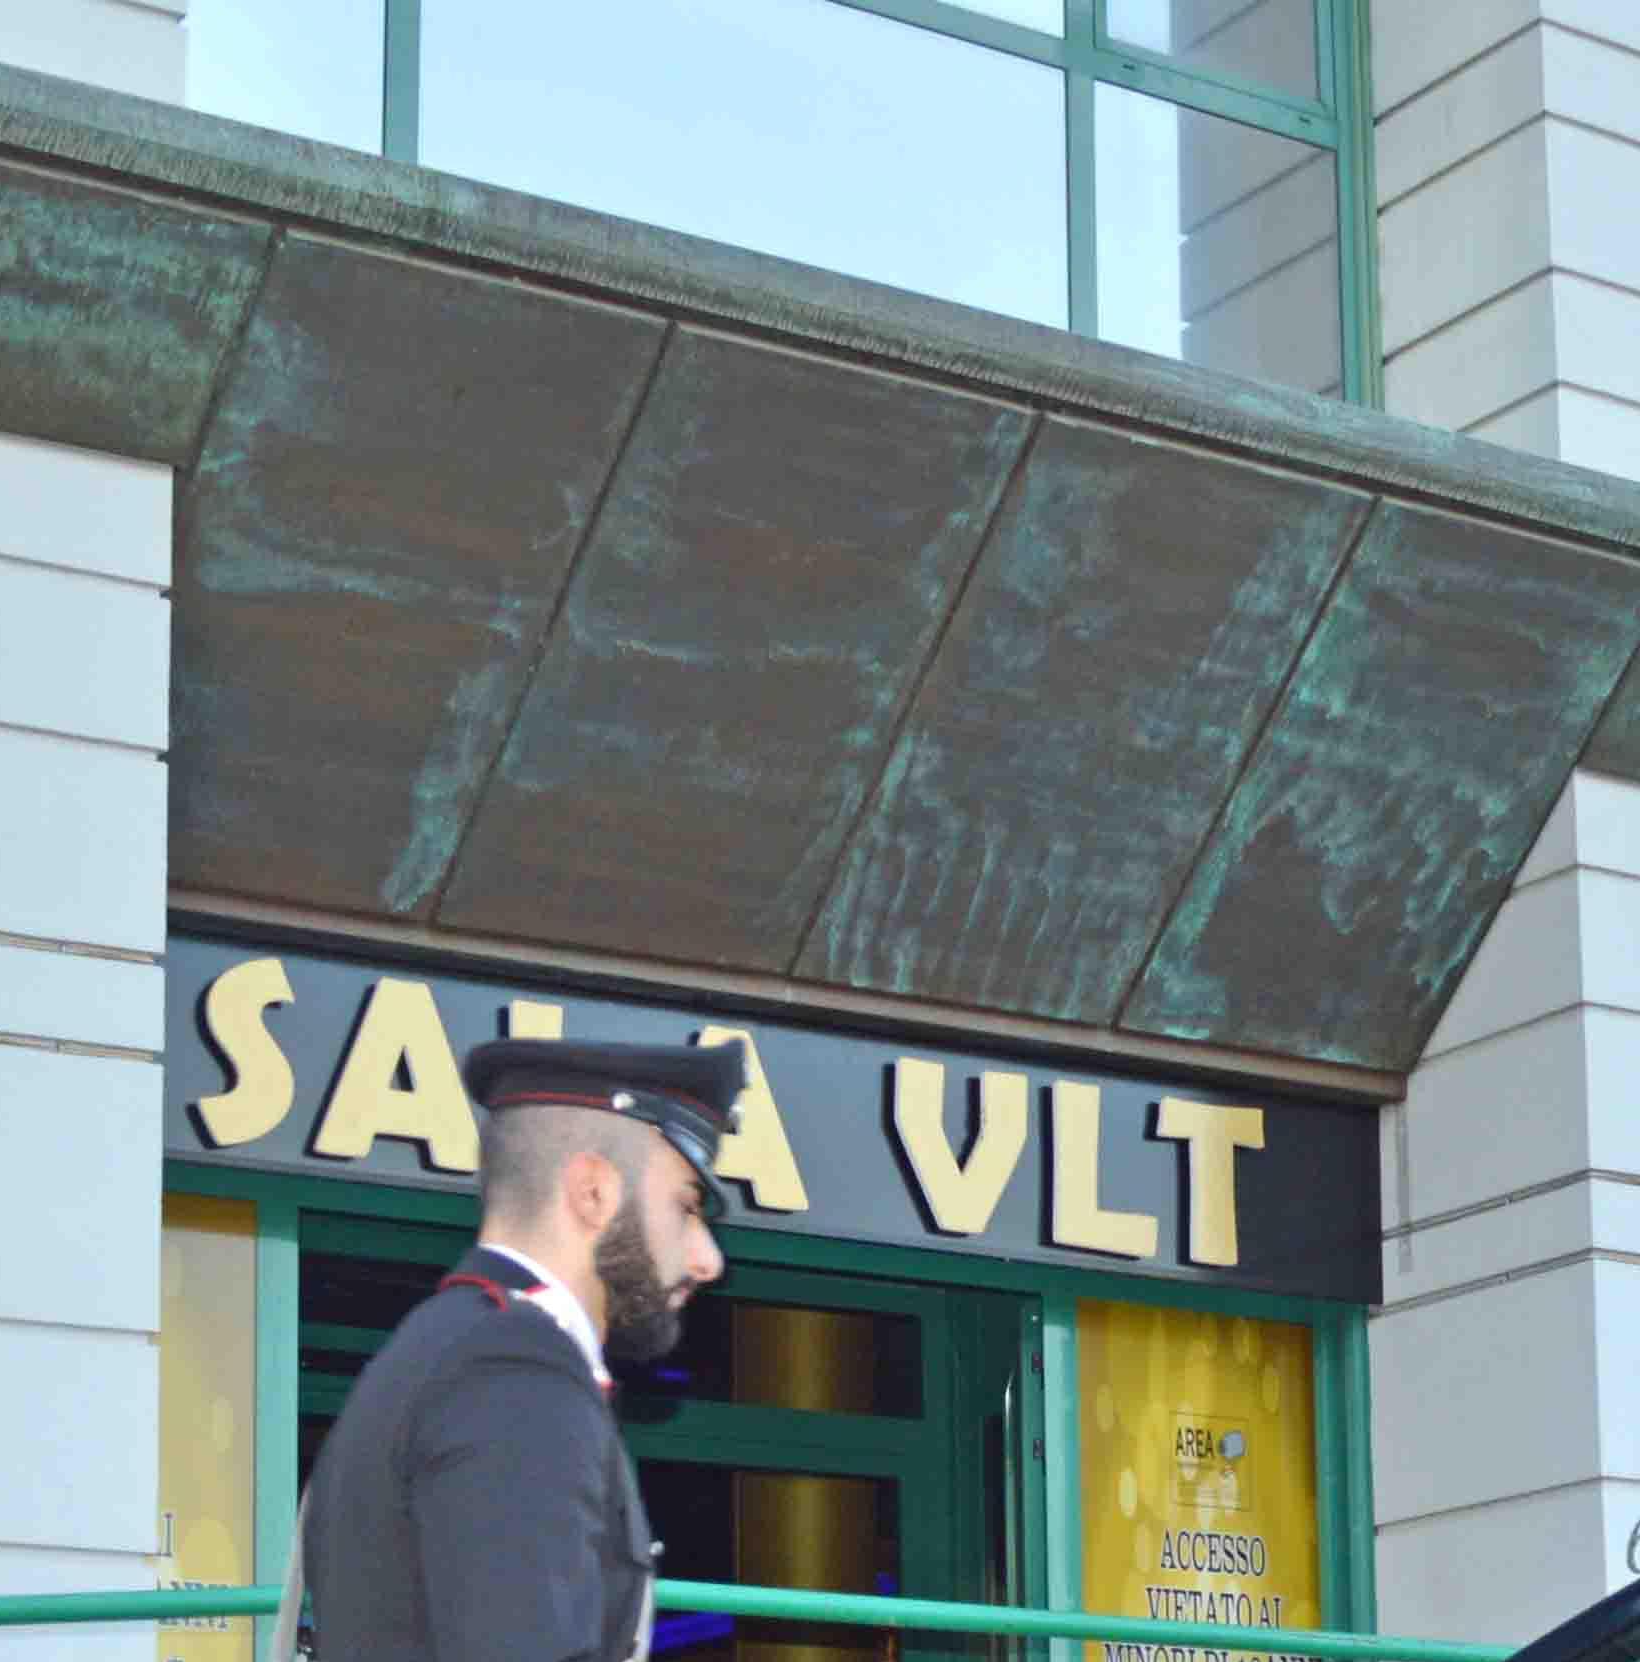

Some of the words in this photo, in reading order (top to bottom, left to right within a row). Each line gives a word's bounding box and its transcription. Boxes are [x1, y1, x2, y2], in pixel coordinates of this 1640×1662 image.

[197, 958, 809, 1212] SAA
[893, 1056, 1266, 1267] VLT
[1175, 1427, 1214, 1460] AREA
[1161, 1529, 1266, 1577] ACCESSO
[1145, 1587, 1253, 1628] VIETATO
